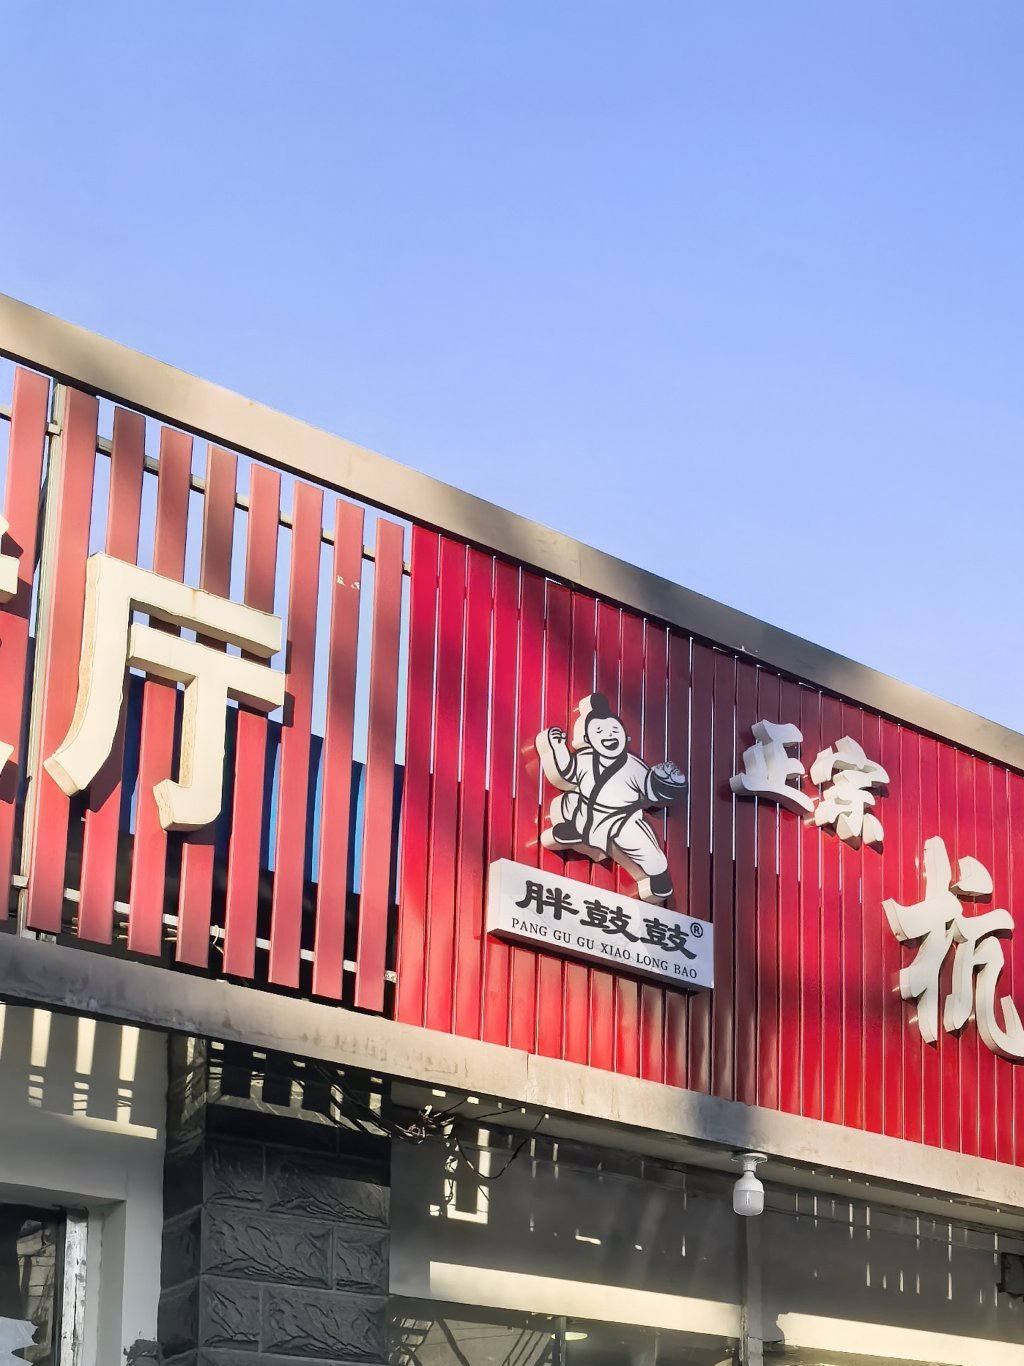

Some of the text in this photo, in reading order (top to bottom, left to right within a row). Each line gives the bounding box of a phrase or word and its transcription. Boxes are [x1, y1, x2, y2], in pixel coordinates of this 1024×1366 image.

[0, 514, 287, 832] 厅
[729, 719, 890, 842] 正宗
[511, 917, 698, 979] PANG GU GU XIAO LONG BAO
